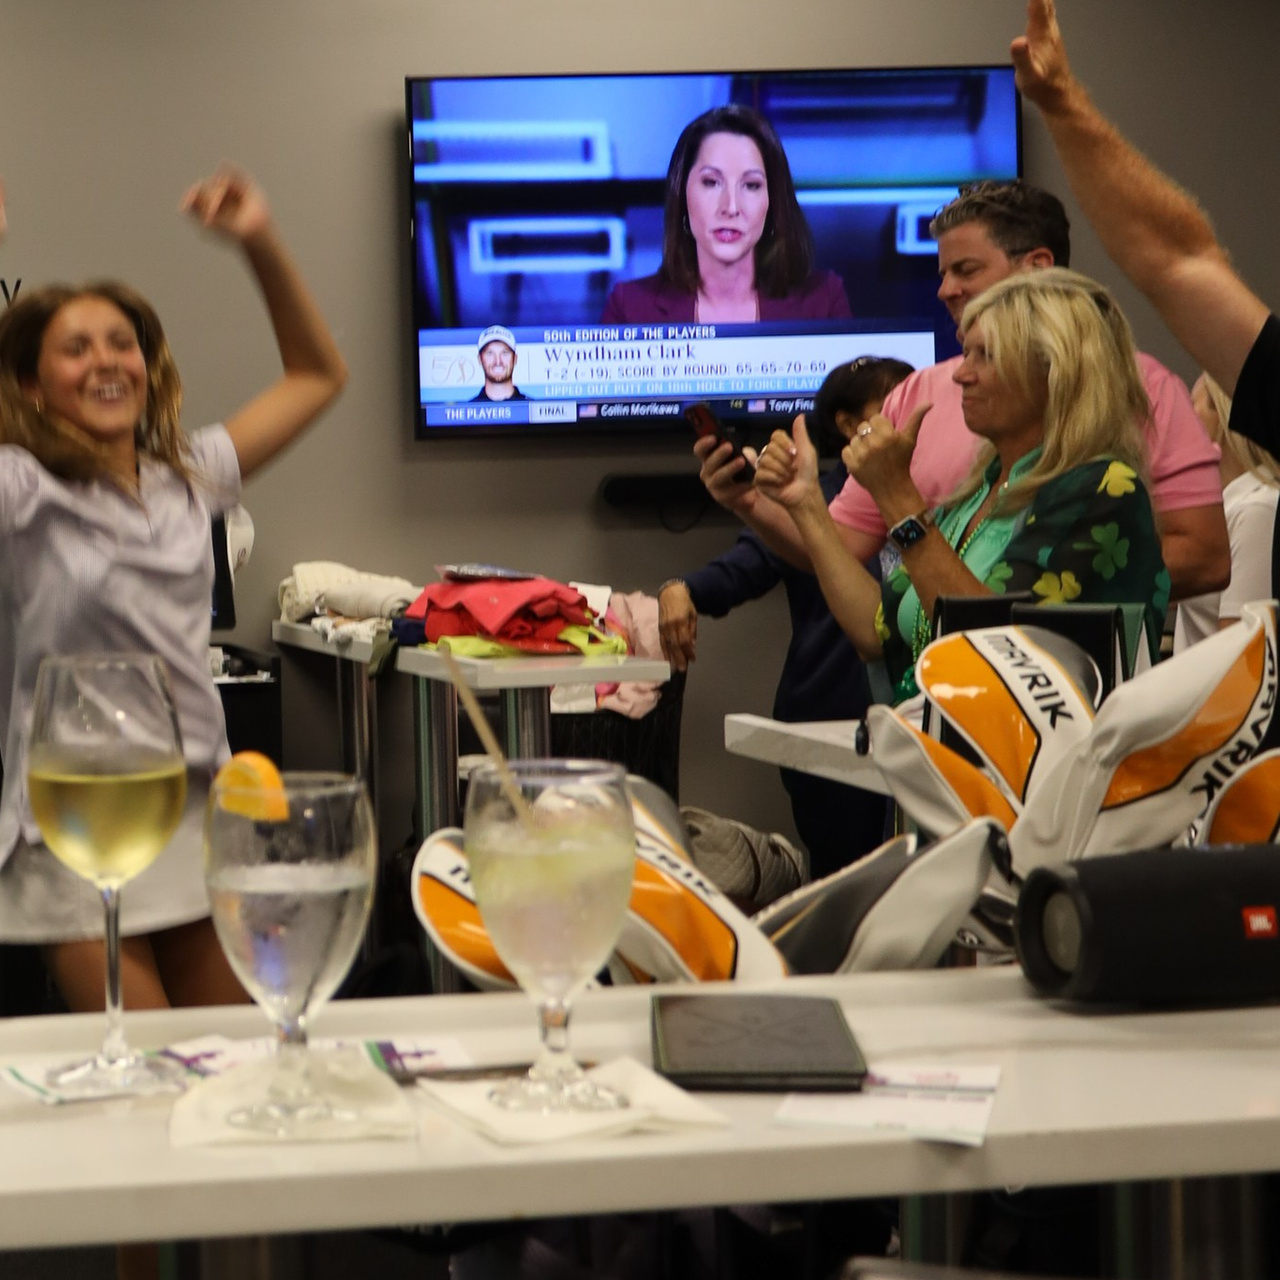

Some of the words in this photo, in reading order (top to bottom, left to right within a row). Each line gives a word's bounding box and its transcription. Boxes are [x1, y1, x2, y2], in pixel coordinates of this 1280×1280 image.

[543, 329, 571, 343] 50th
[575, 327, 619, 342] EDITION
[623, 327, 638, 341] OF
[641, 326, 663, 341] THE
[668, 325, 716, 340] PLAYERS
[545, 345, 642, 366] Wyndham
[646, 343, 696, 360] Clark
[618, 365, 656, 379] SCORE
[662, 365, 678, 378] BY
[683, 363, 730, 377] ROUND:
[736, 360, 827, 376] 65-65-70-69
[544, 383, 583, 398] LIPPED
[587, 382, 610, 396] OUT
[614, 381, 642, 395] PUTT
[646, 380, 663, 394] ON
[696, 379, 725, 392] HOLE
[730, 378, 744, 391] TO
[748, 377, 783, 391] FORCE
[445, 408, 465, 420] THE
[467, 406, 512, 419] PLAYERS
[539, 405, 566, 416] FINAL
[601, 403, 629, 417] Collin
[630, 402, 680, 416] Morikawa
[768, 399, 794, 414] Tony
